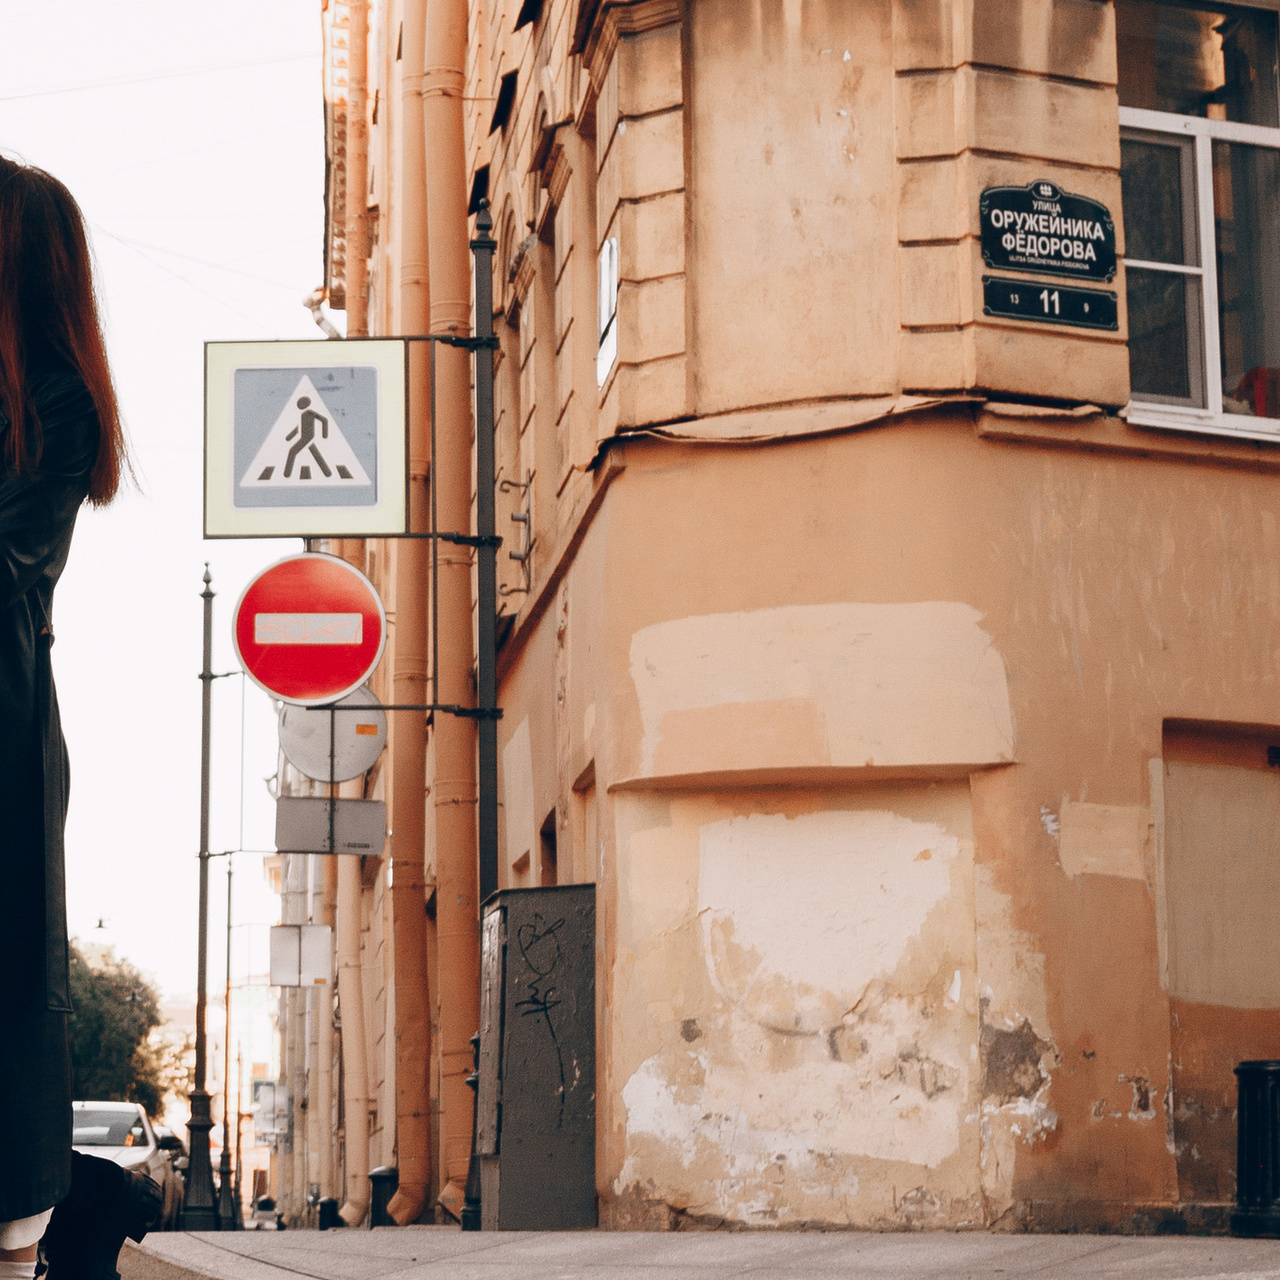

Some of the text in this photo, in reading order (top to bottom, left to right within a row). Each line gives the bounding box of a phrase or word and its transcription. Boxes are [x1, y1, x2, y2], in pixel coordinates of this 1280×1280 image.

[1032, 200, 1062, 214] УЛИЦА
[991, 209, 1105, 241] ОРУЖЕЙНИКА
[1002, 230, 1097, 261] ФЁДОРОВА
[1010, 289, 1090, 315] 13 11 9
